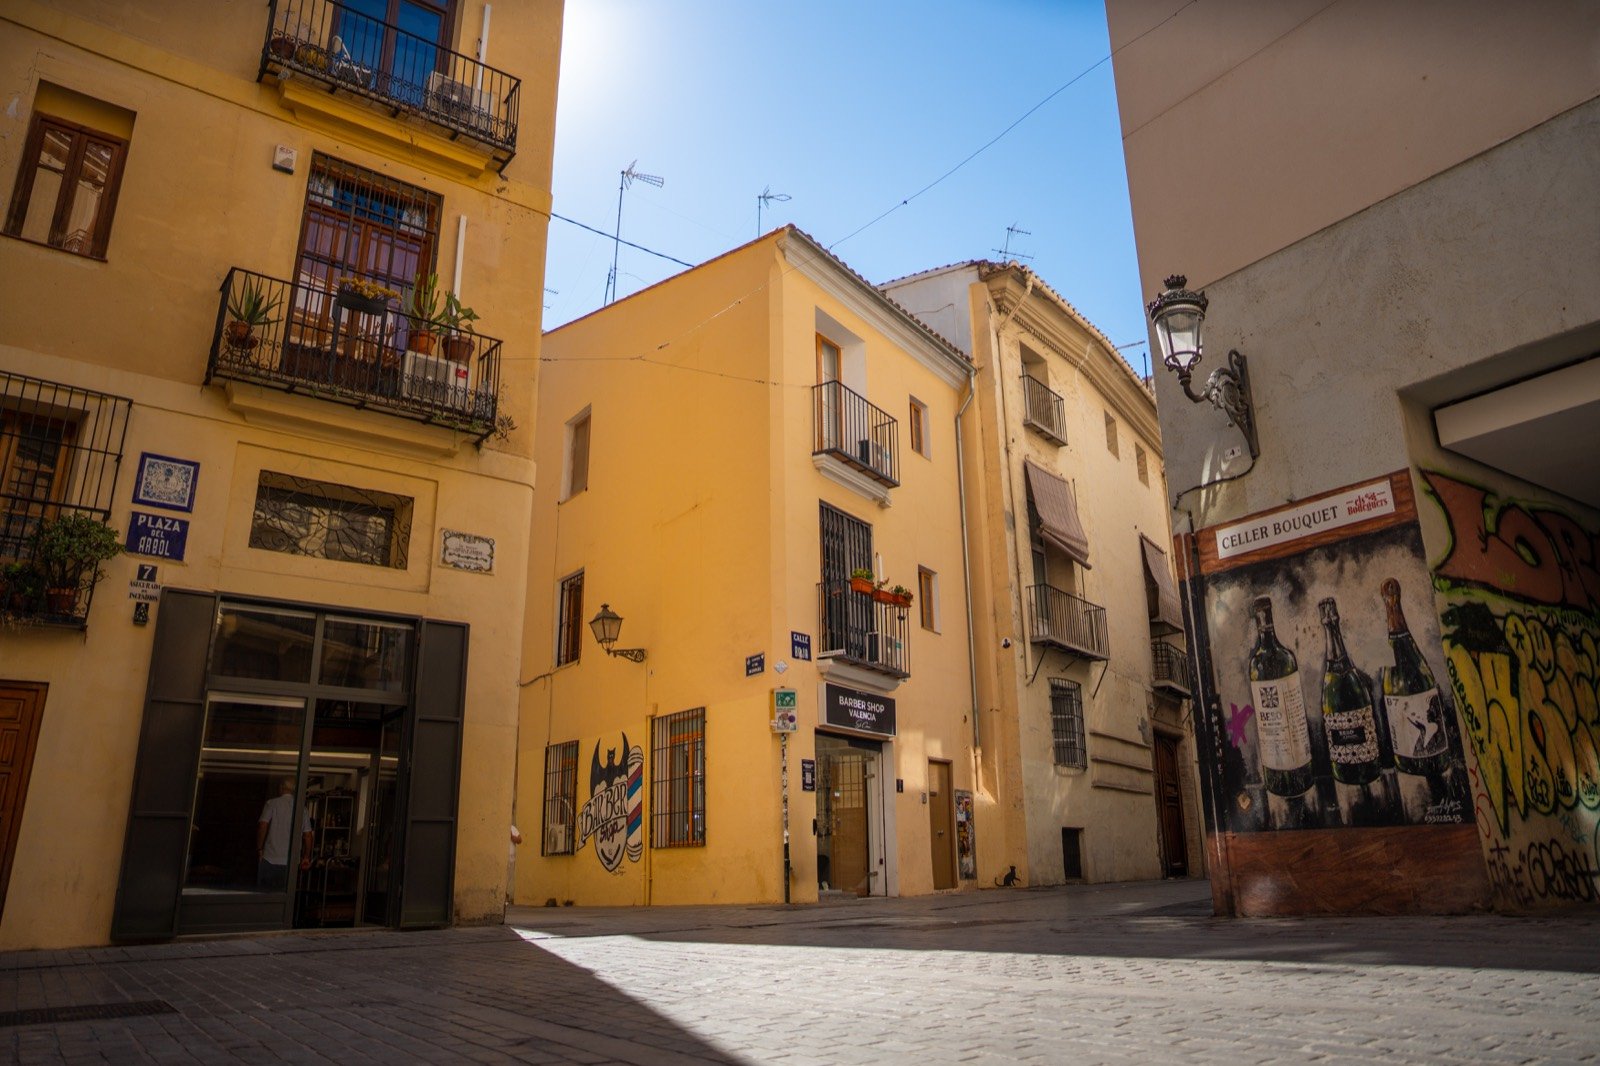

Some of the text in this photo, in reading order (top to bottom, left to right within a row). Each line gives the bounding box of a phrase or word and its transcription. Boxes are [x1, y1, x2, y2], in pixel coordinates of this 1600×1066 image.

[138, 514, 180, 532] PLAZA
[1222, 505, 1339, 550] CELLER BOUQUET
[151, 529, 164, 538] DEL
[142, 566, 153, 579] 7
[793, 633, 809, 644] CALLE
[838, 695, 885, 713] BARBER SHOP
[848, 708, 877, 722] VALENCIA
